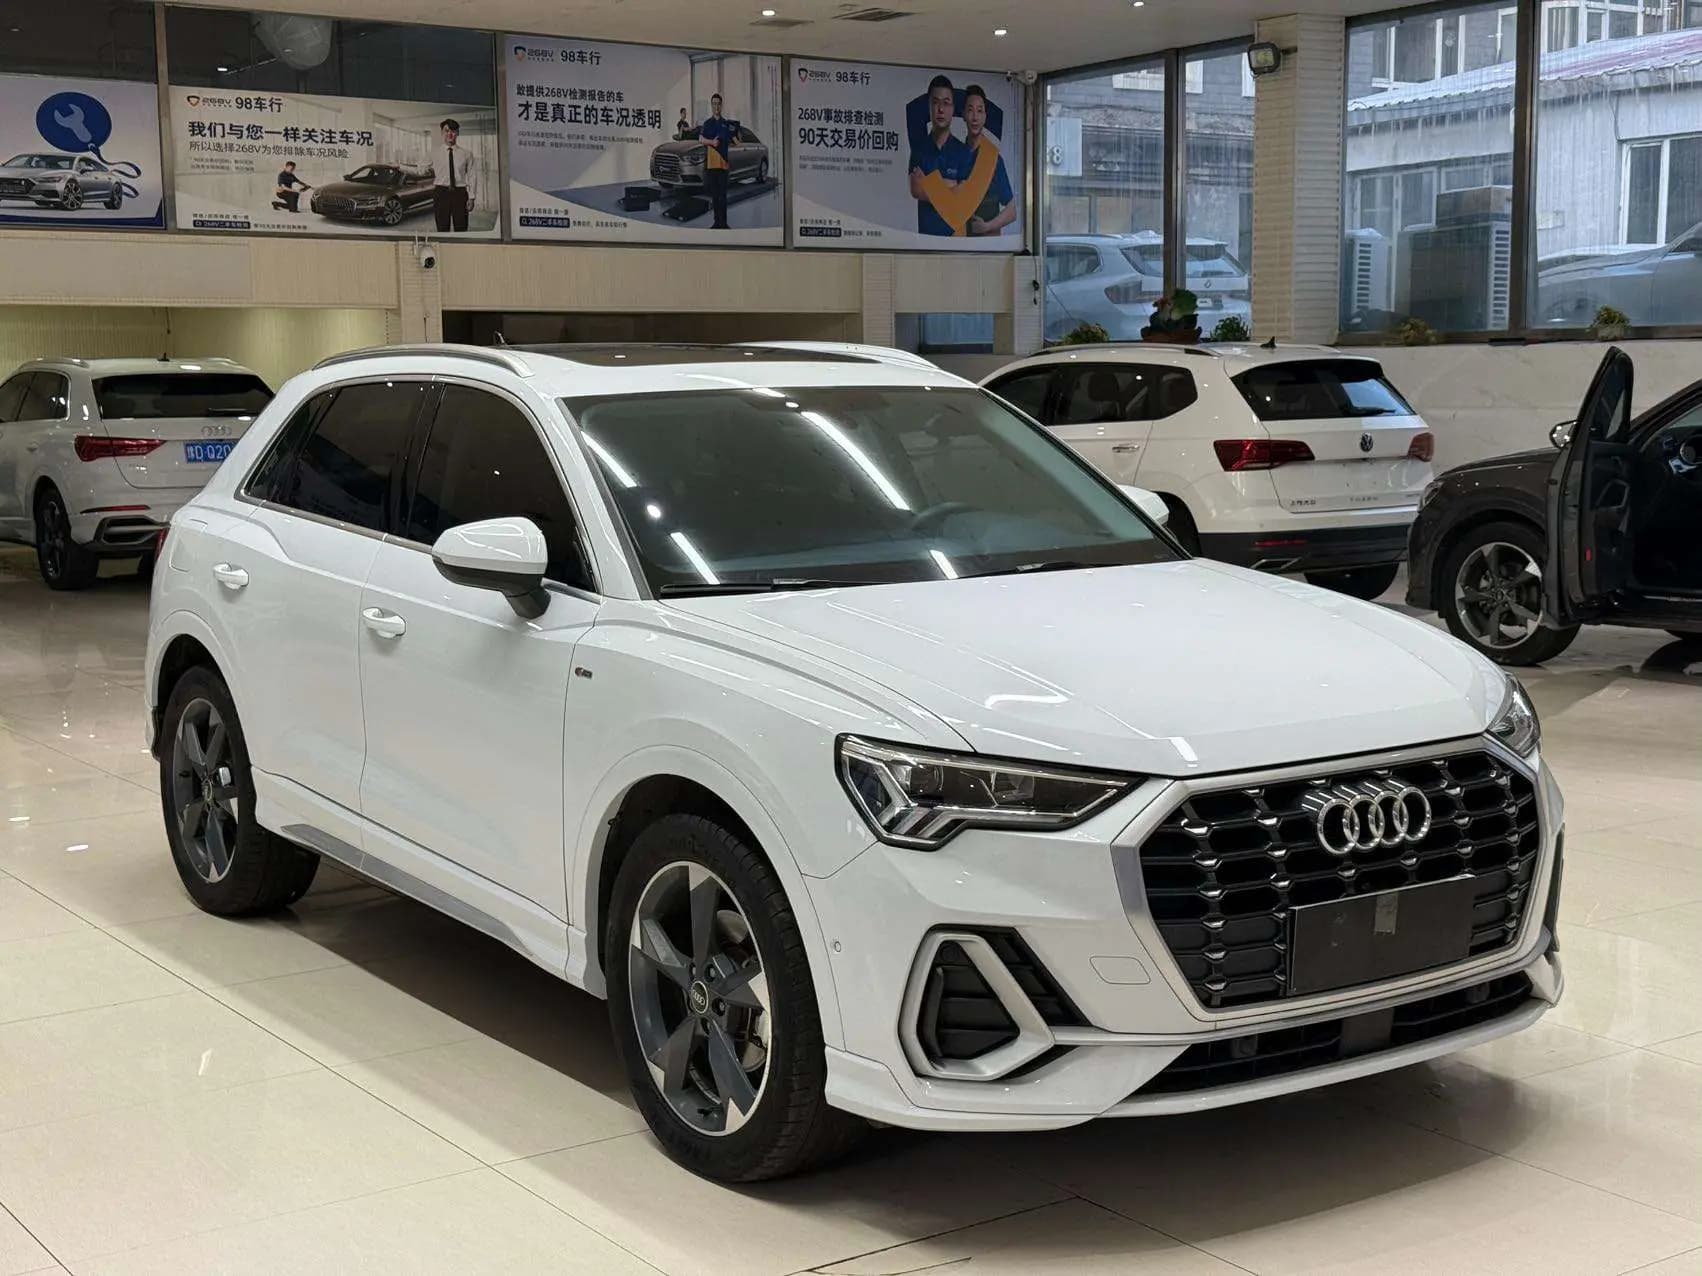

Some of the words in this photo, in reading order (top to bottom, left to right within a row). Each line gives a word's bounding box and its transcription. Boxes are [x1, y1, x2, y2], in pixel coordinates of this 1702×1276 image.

[560, 49, 602, 65] 98车行
[835, 71, 871, 86] 98车行
[516, 84, 624, 103] 敢提供268V检测报告的车
[235, 96, 283, 113] 98车行
[517, 100, 662, 129] 才是真正的车况透明
[798, 107, 884, 126] 268V事故排查检测
[188, 120, 374, 147] 我们与您一样关注车况
[798, 127, 899, 151] 90天交易价回购
[189, 141, 350, 159] 所以选择268V为您排除车况风险
